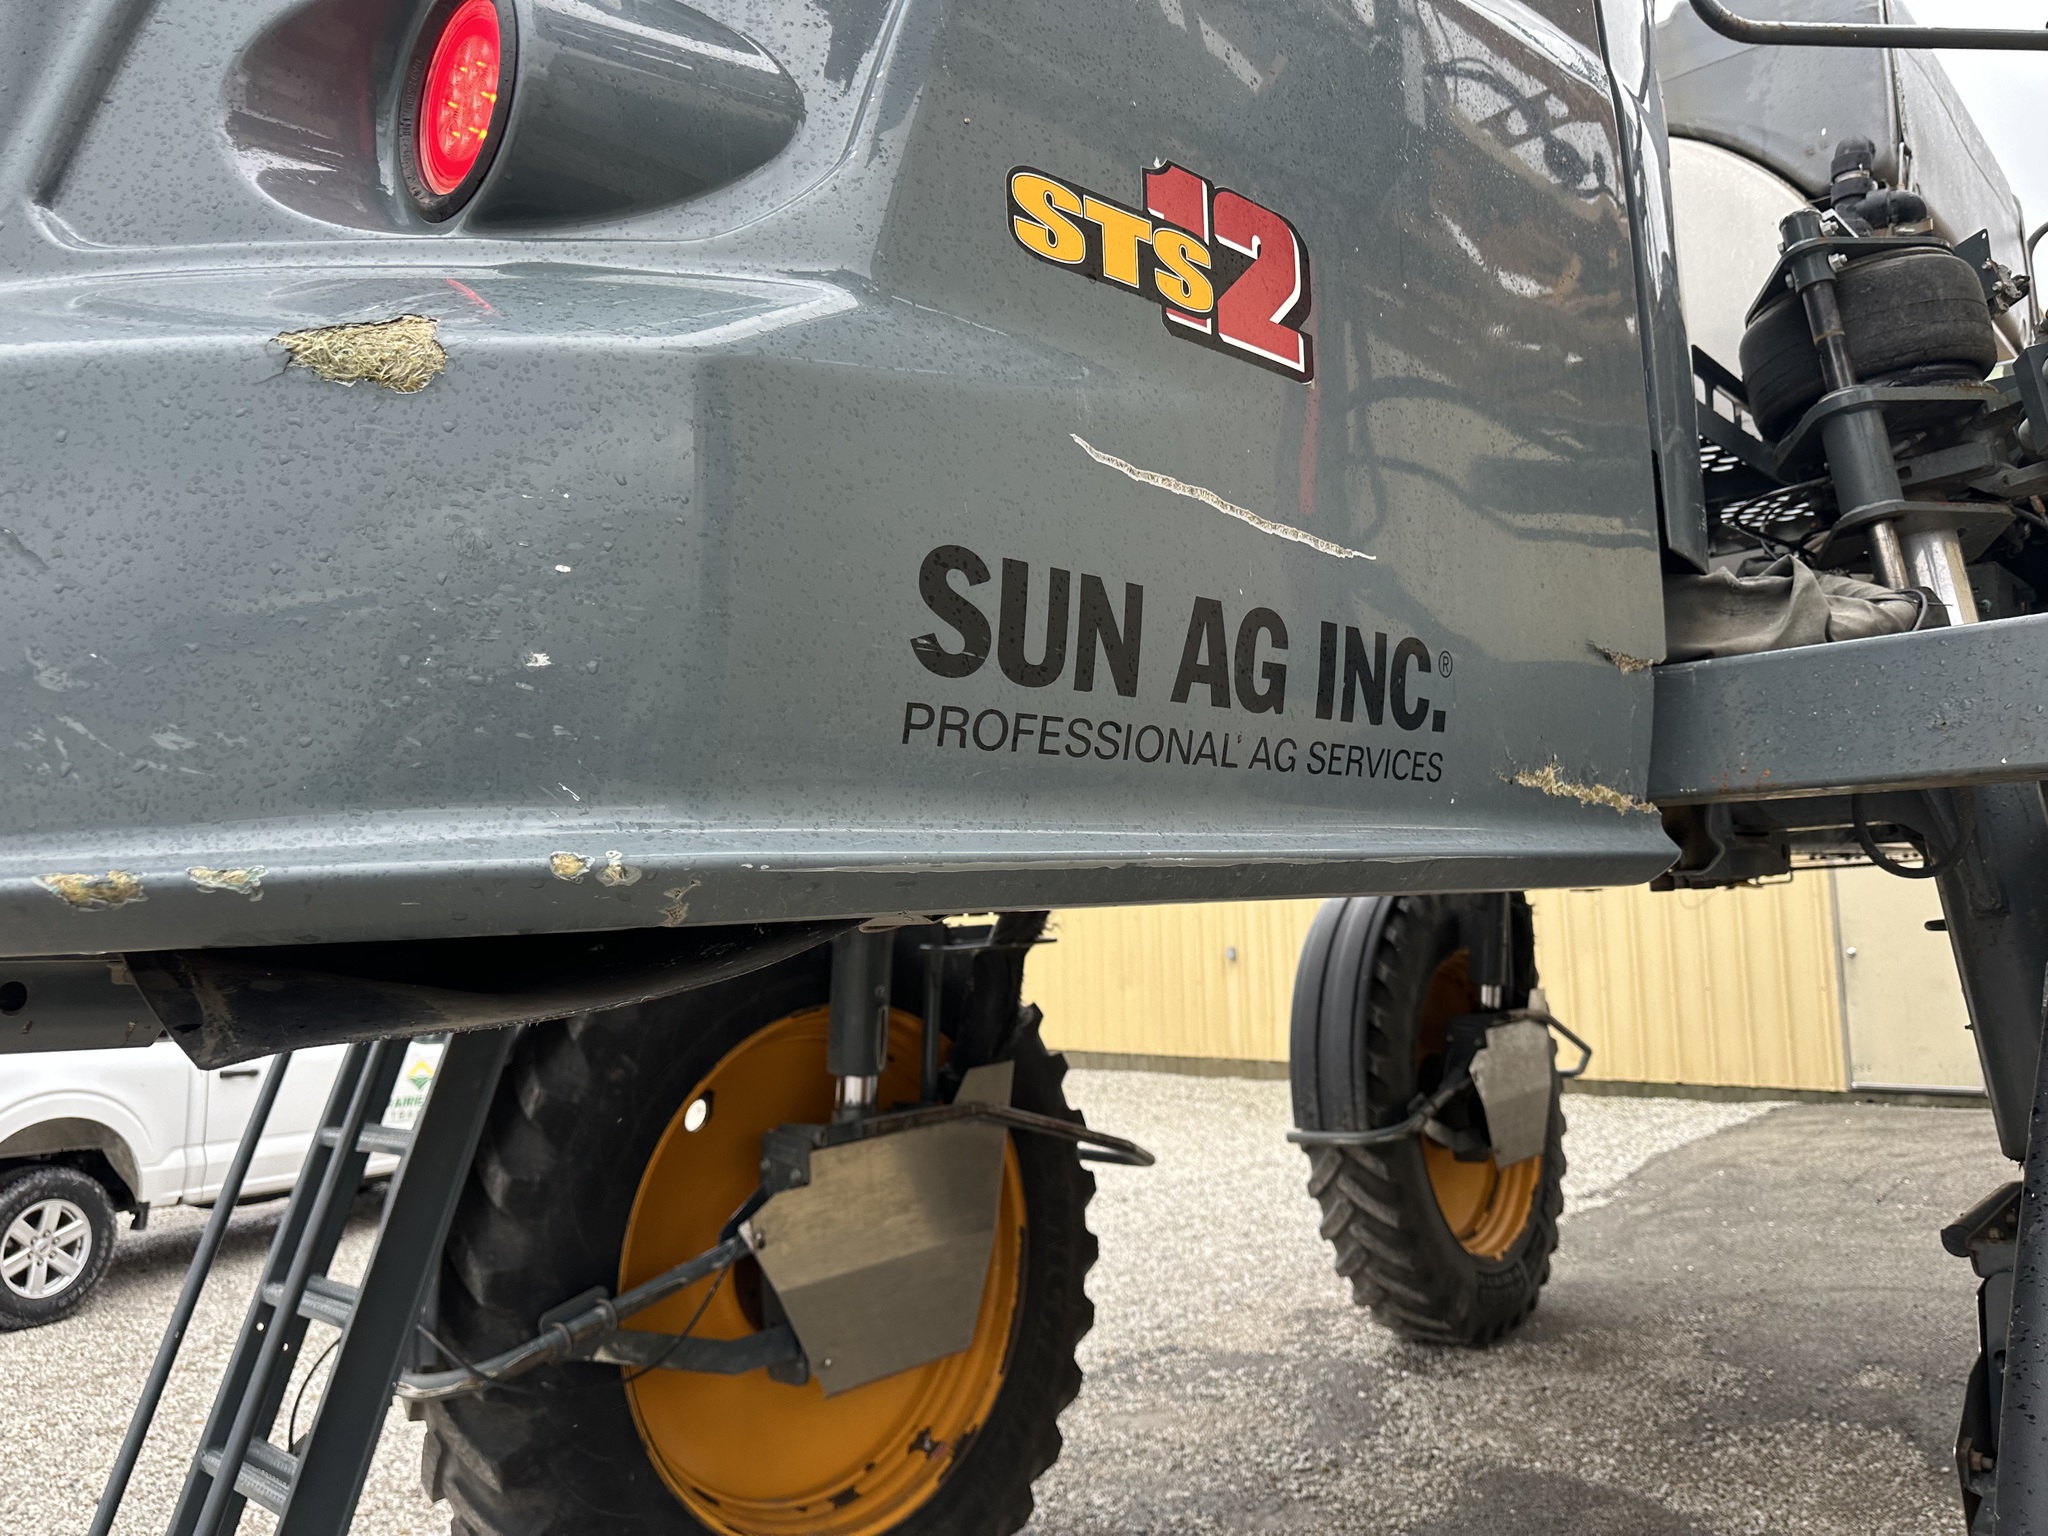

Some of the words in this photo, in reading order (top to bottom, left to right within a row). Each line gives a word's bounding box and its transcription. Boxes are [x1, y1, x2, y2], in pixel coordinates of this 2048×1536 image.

[1012, 172, 1214, 313] STS
[1146, 165, 1305, 373] 12
[910, 544, 1144, 698] SUN
[1169, 595, 1289, 715] AG
[902, 702, 1239, 769] PROFESSIONAL
[1248, 736, 1298, 773] AG
[1306, 741, 1444, 783] SERVICES
